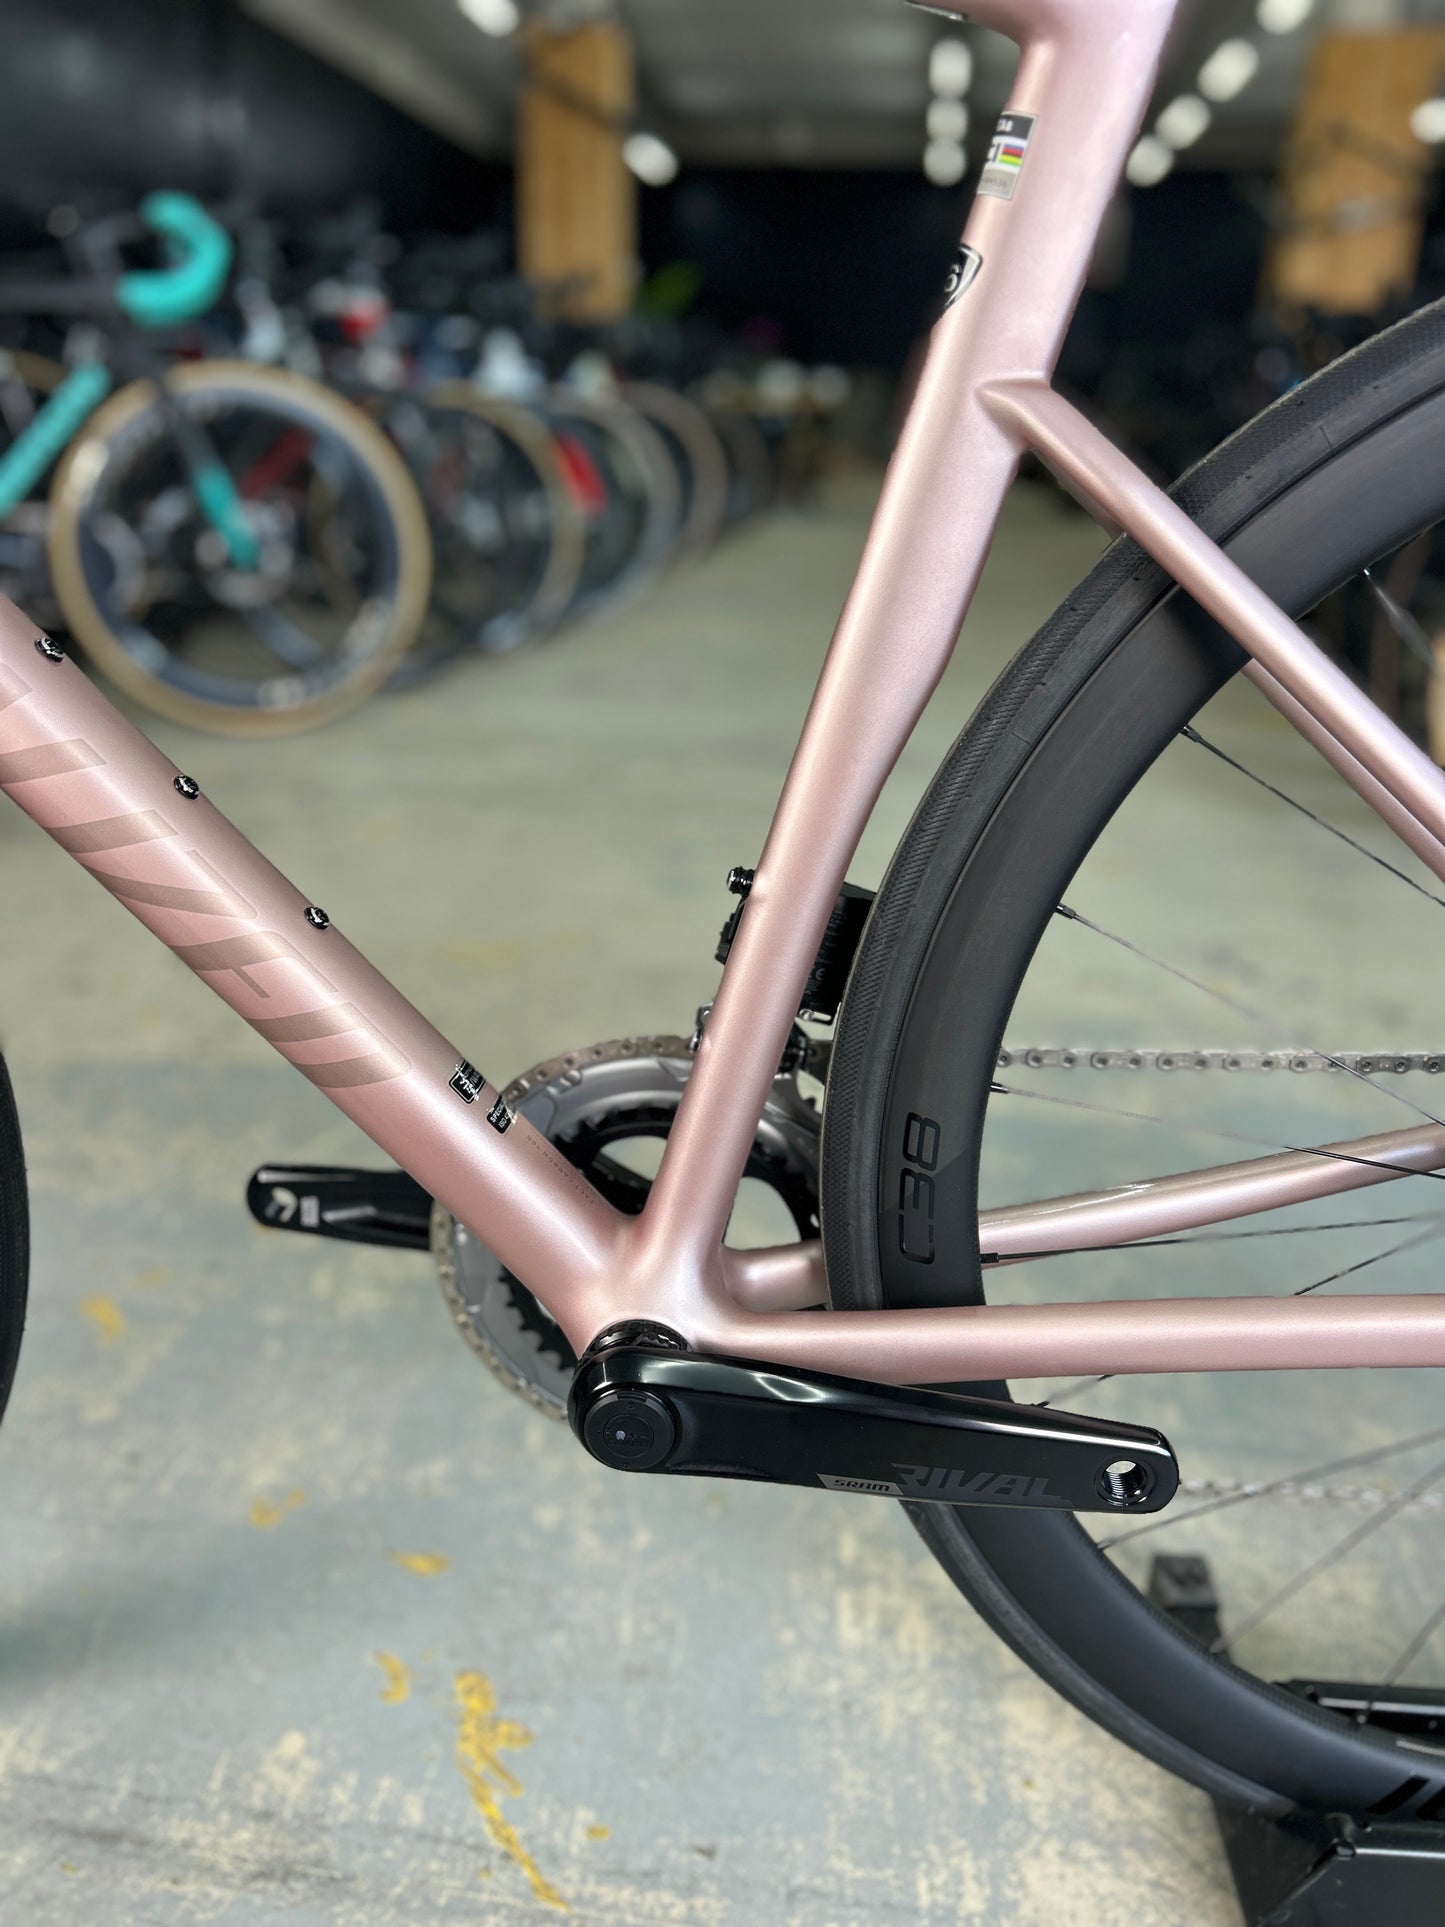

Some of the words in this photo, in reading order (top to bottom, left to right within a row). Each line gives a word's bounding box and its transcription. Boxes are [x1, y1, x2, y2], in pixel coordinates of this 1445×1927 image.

[898, 1111, 941, 1265] C38
[833, 1478, 890, 1493] SRAM
[891, 1462, 1066, 1502] RIVAL
